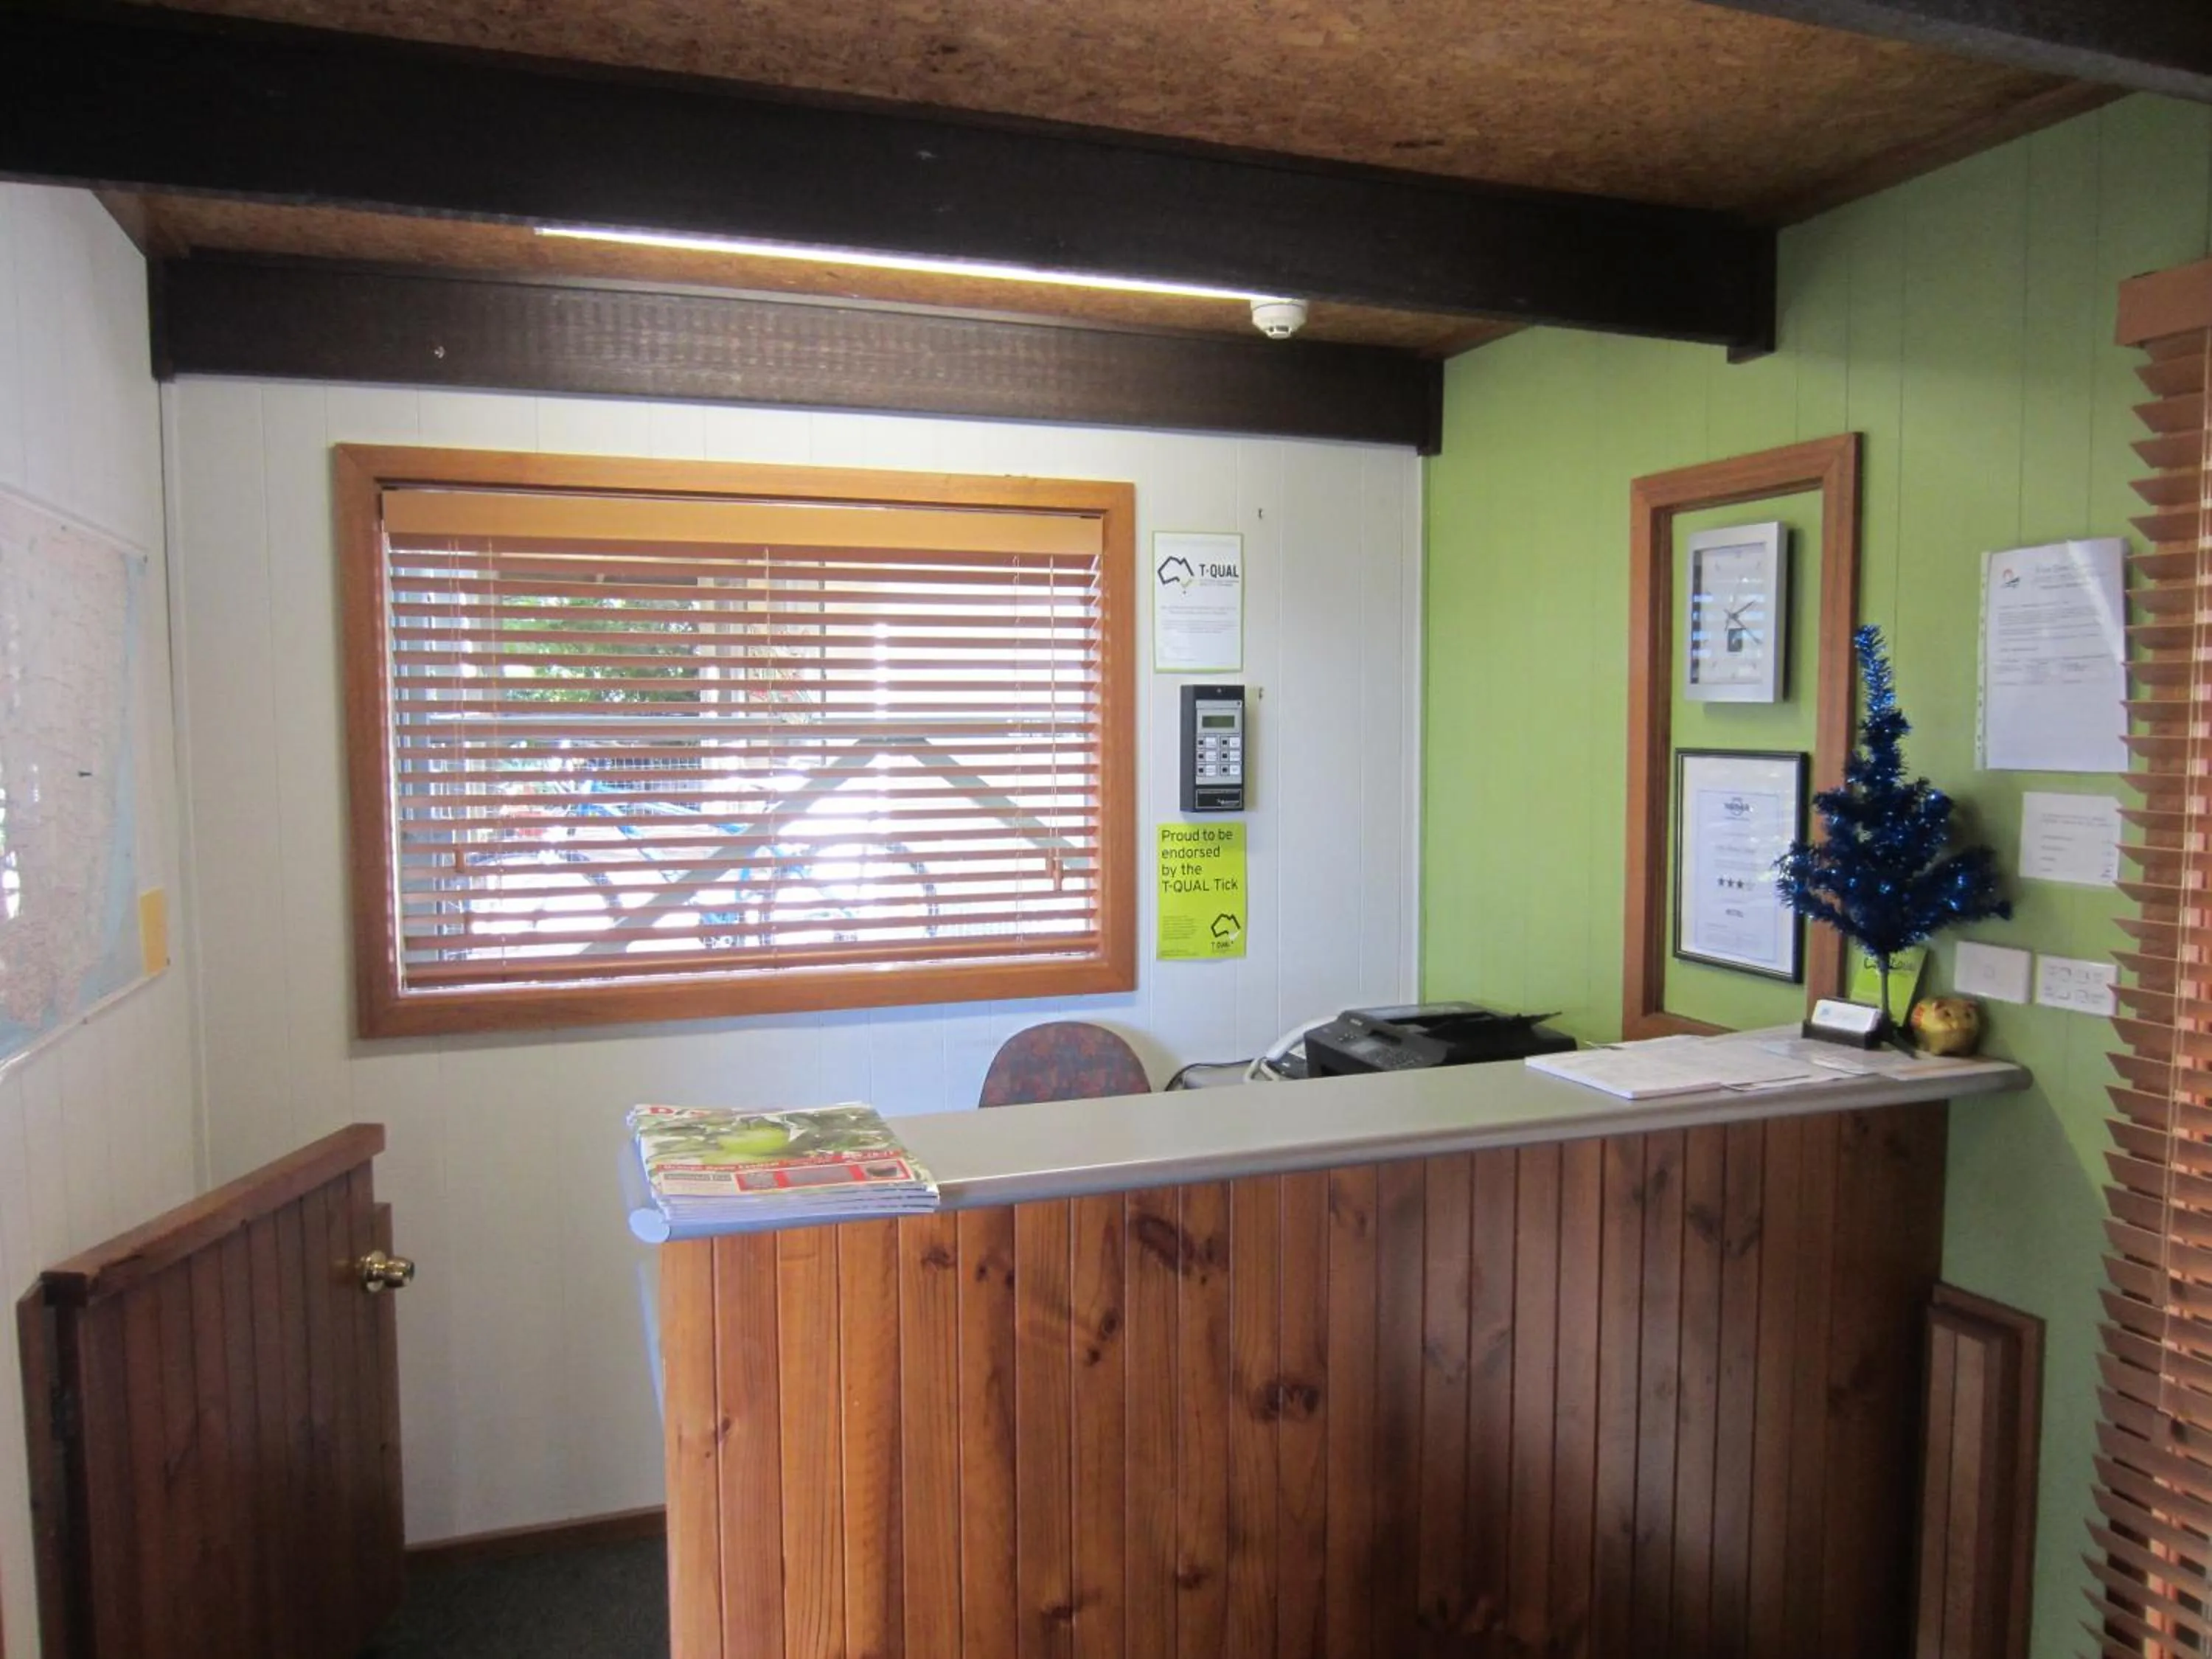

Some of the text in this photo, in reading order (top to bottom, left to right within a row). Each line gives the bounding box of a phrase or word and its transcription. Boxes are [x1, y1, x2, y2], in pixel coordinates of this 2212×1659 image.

[1161, 828, 1234, 842] Proud to be
[1161, 846, 1220, 859] endorsed
[1161, 863, 1203, 878] by the
[1214, 878, 1239, 891] Tick
